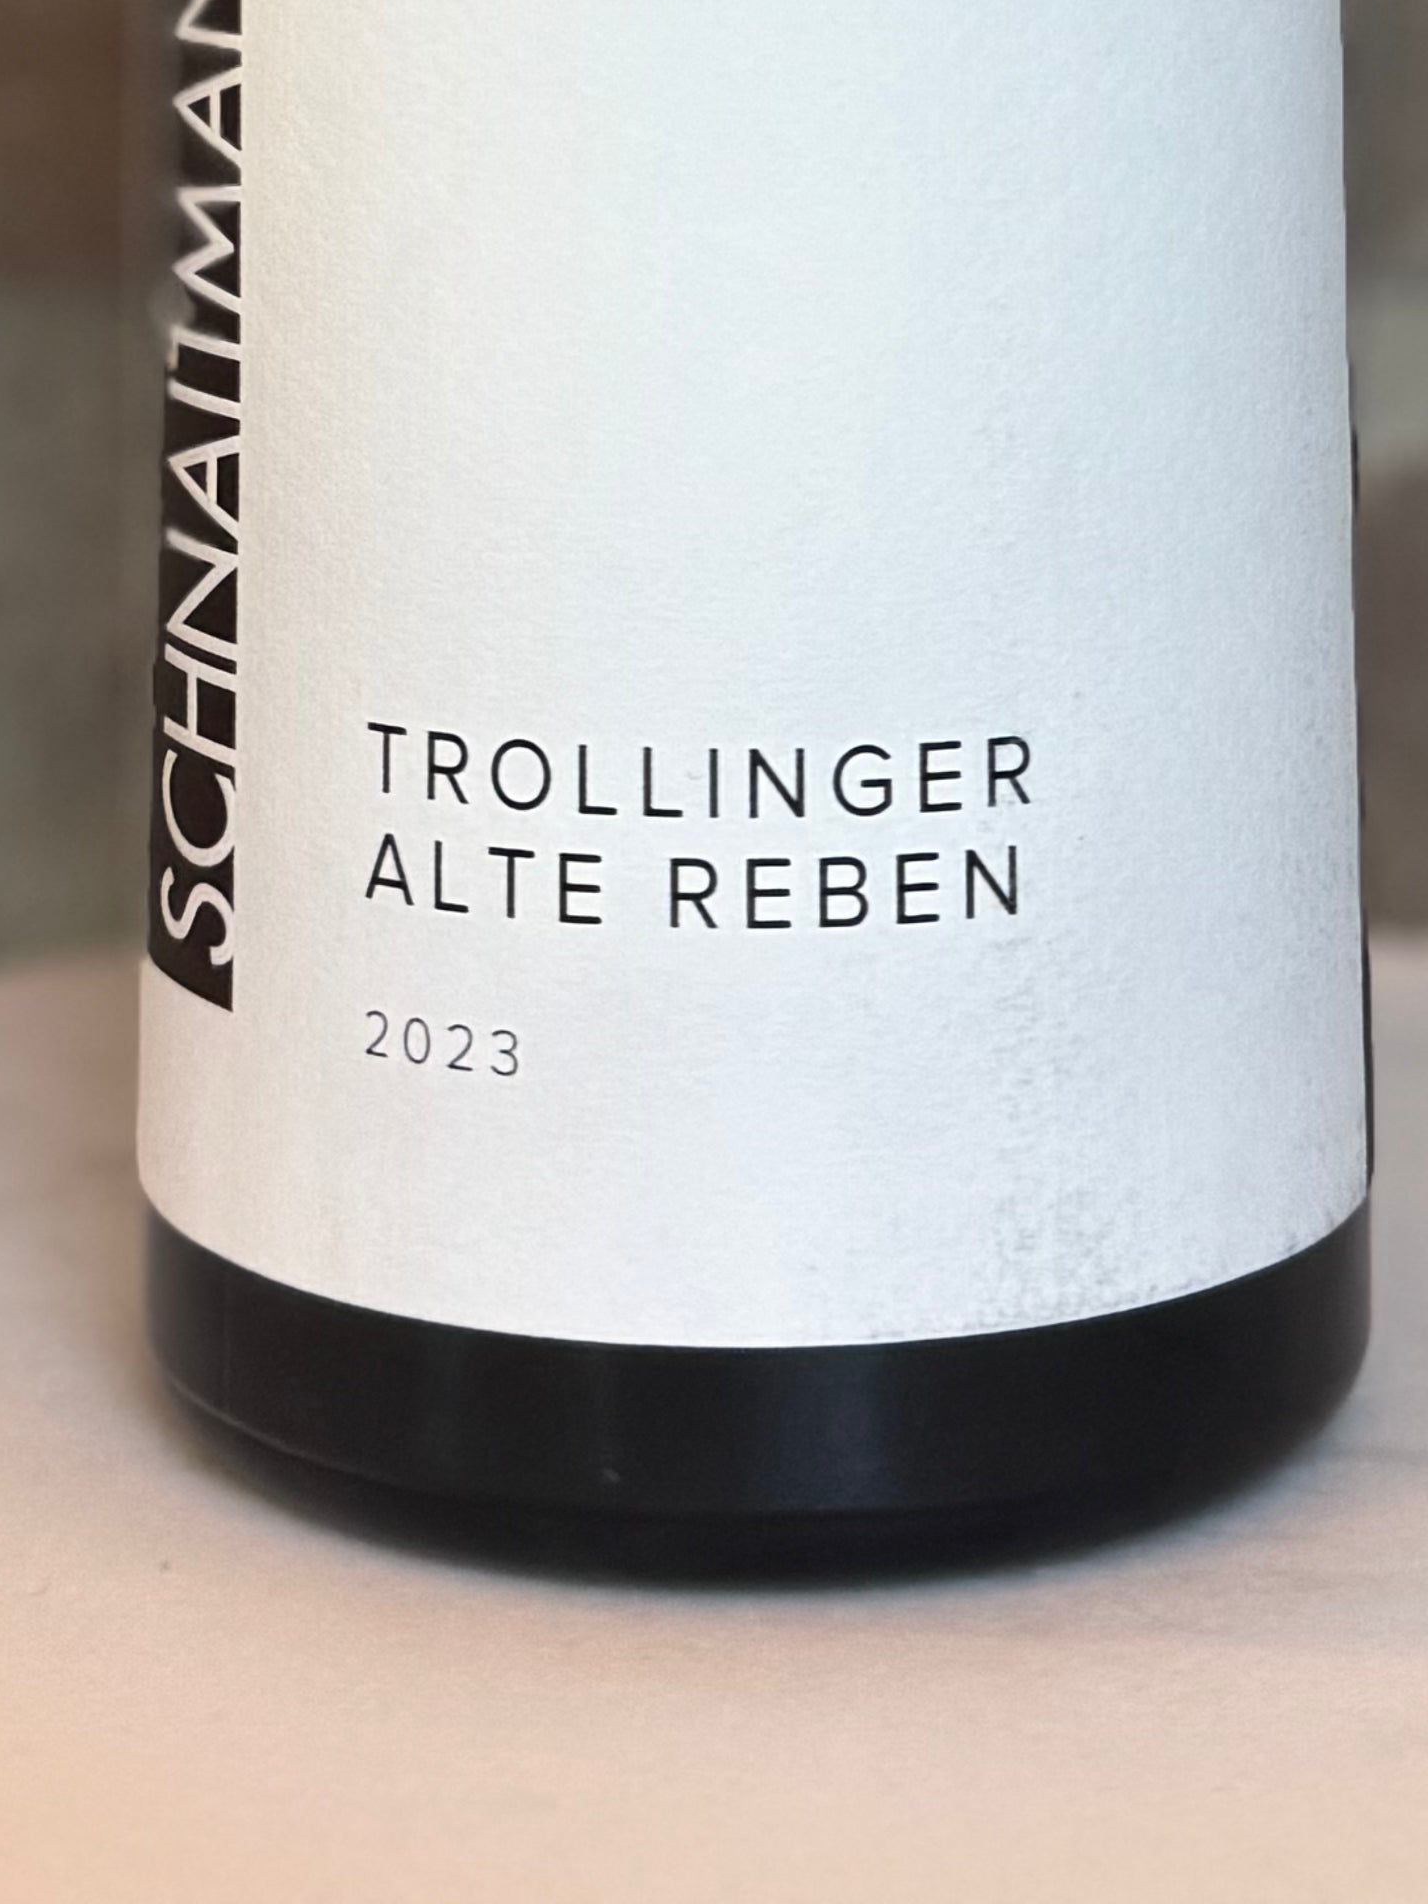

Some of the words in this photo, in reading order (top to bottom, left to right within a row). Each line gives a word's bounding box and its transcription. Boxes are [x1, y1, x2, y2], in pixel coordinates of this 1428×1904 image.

[366, 720, 1032, 820] TROLLINGER
[364, 832, 605, 926] ALTE
[668, 844, 1022, 931] REBEN
[365, 1009, 522, 1078] 2023
